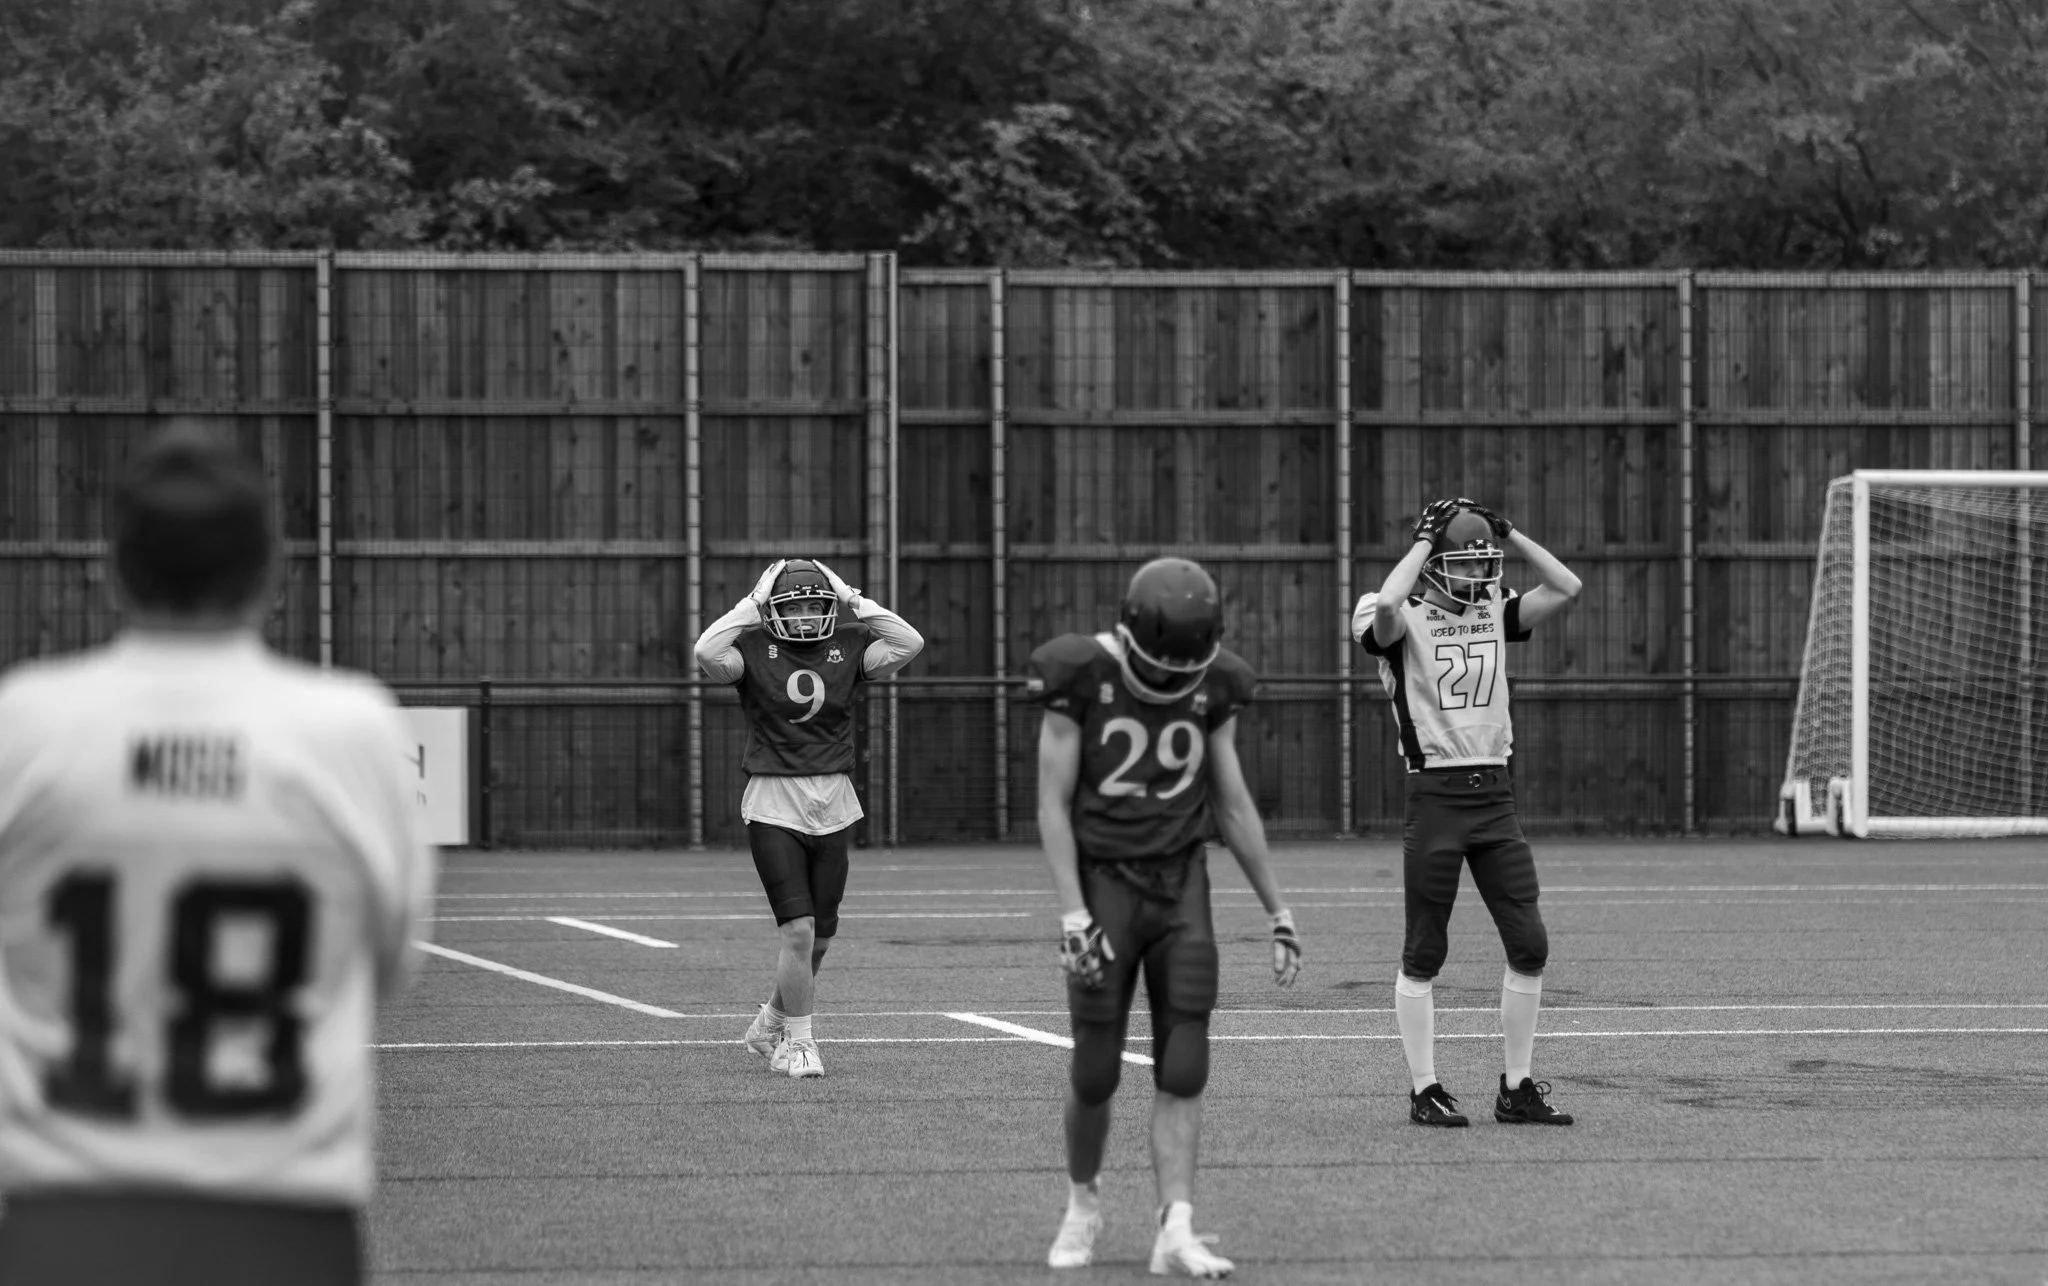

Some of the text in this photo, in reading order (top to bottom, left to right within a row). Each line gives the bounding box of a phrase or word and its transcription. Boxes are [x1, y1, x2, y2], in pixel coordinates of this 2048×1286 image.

[1430, 623, 1495, 637] USED TO BEES
[786, 669, 825, 724] 9
[1435, 640, 1498, 711] 27
[1098, 717, 1205, 799] 29
[40, 868, 316, 1125] 18
